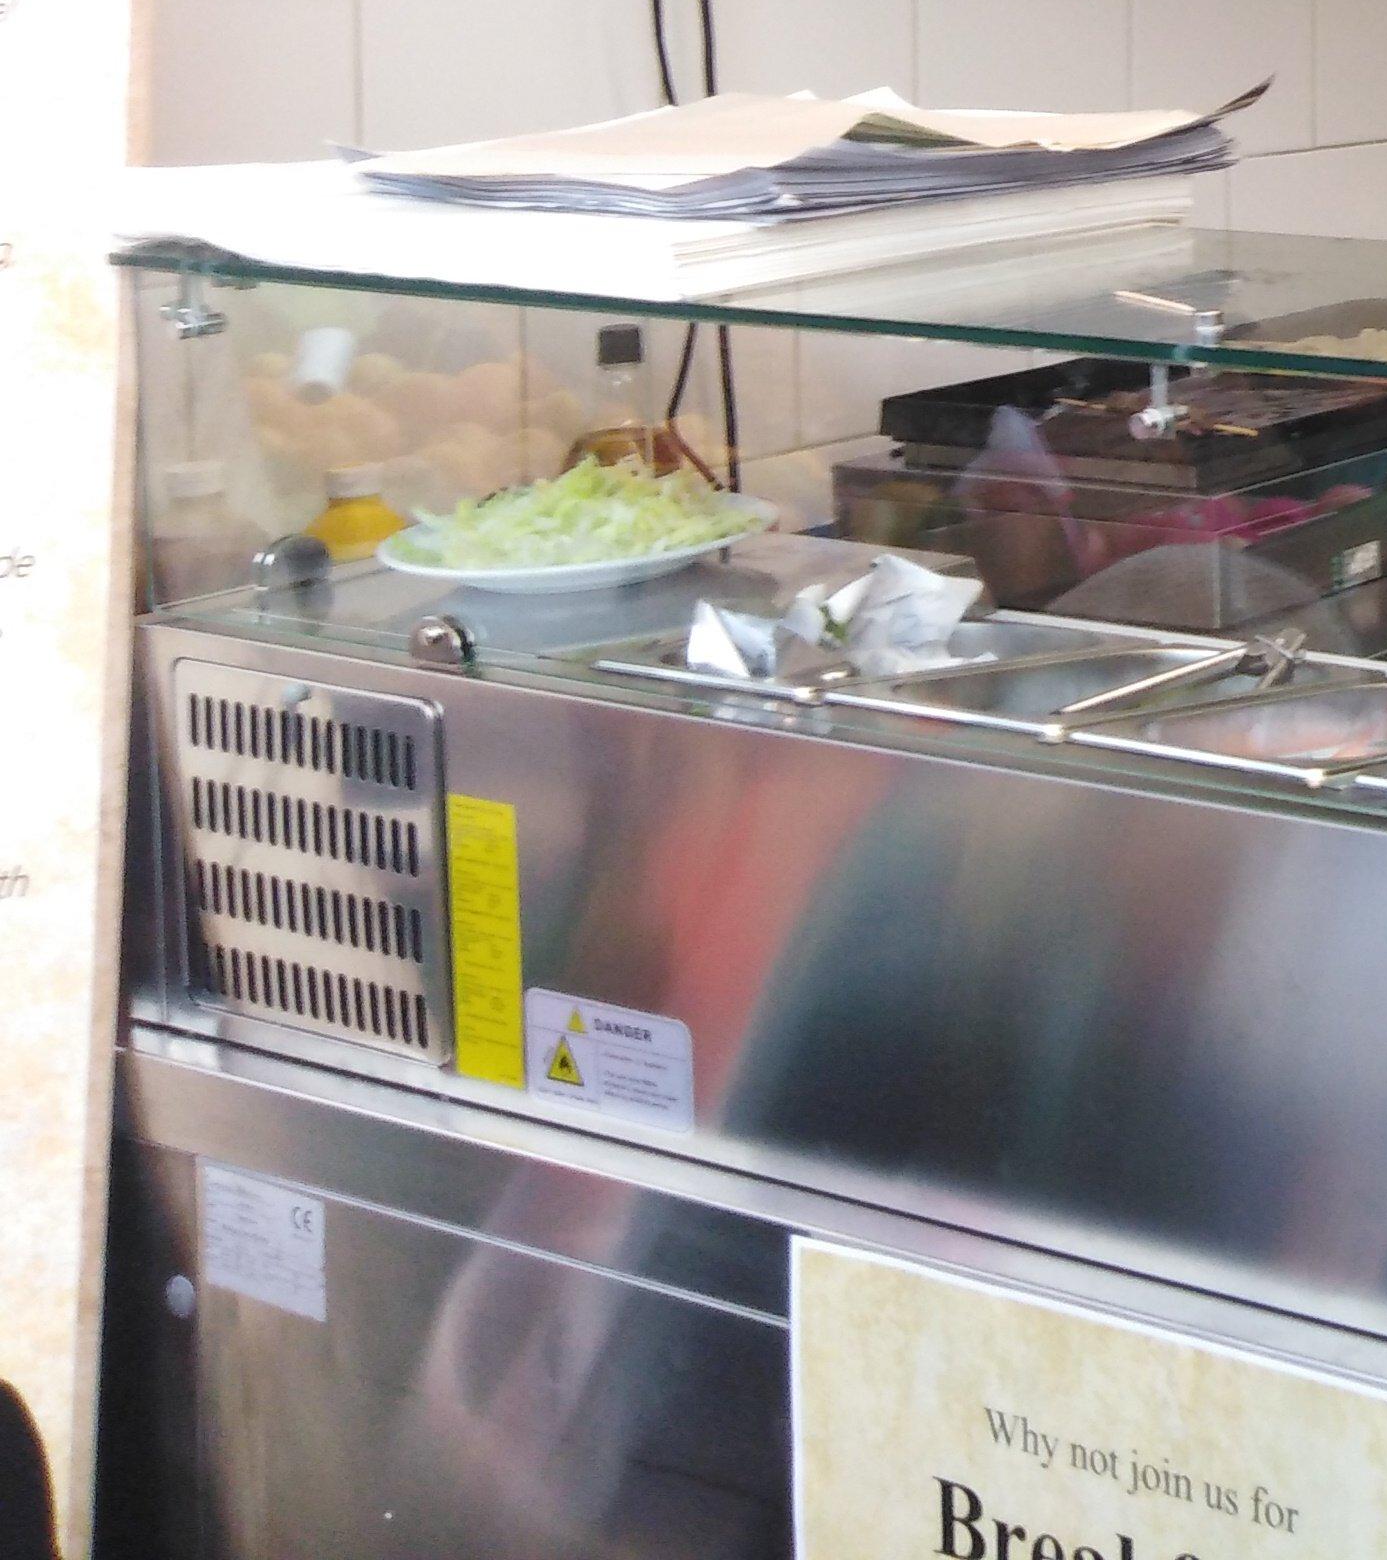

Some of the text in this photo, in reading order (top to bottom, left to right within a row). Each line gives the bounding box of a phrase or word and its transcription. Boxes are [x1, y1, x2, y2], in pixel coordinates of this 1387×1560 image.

[985, 1407, 1300, 1534] Why not join us for
